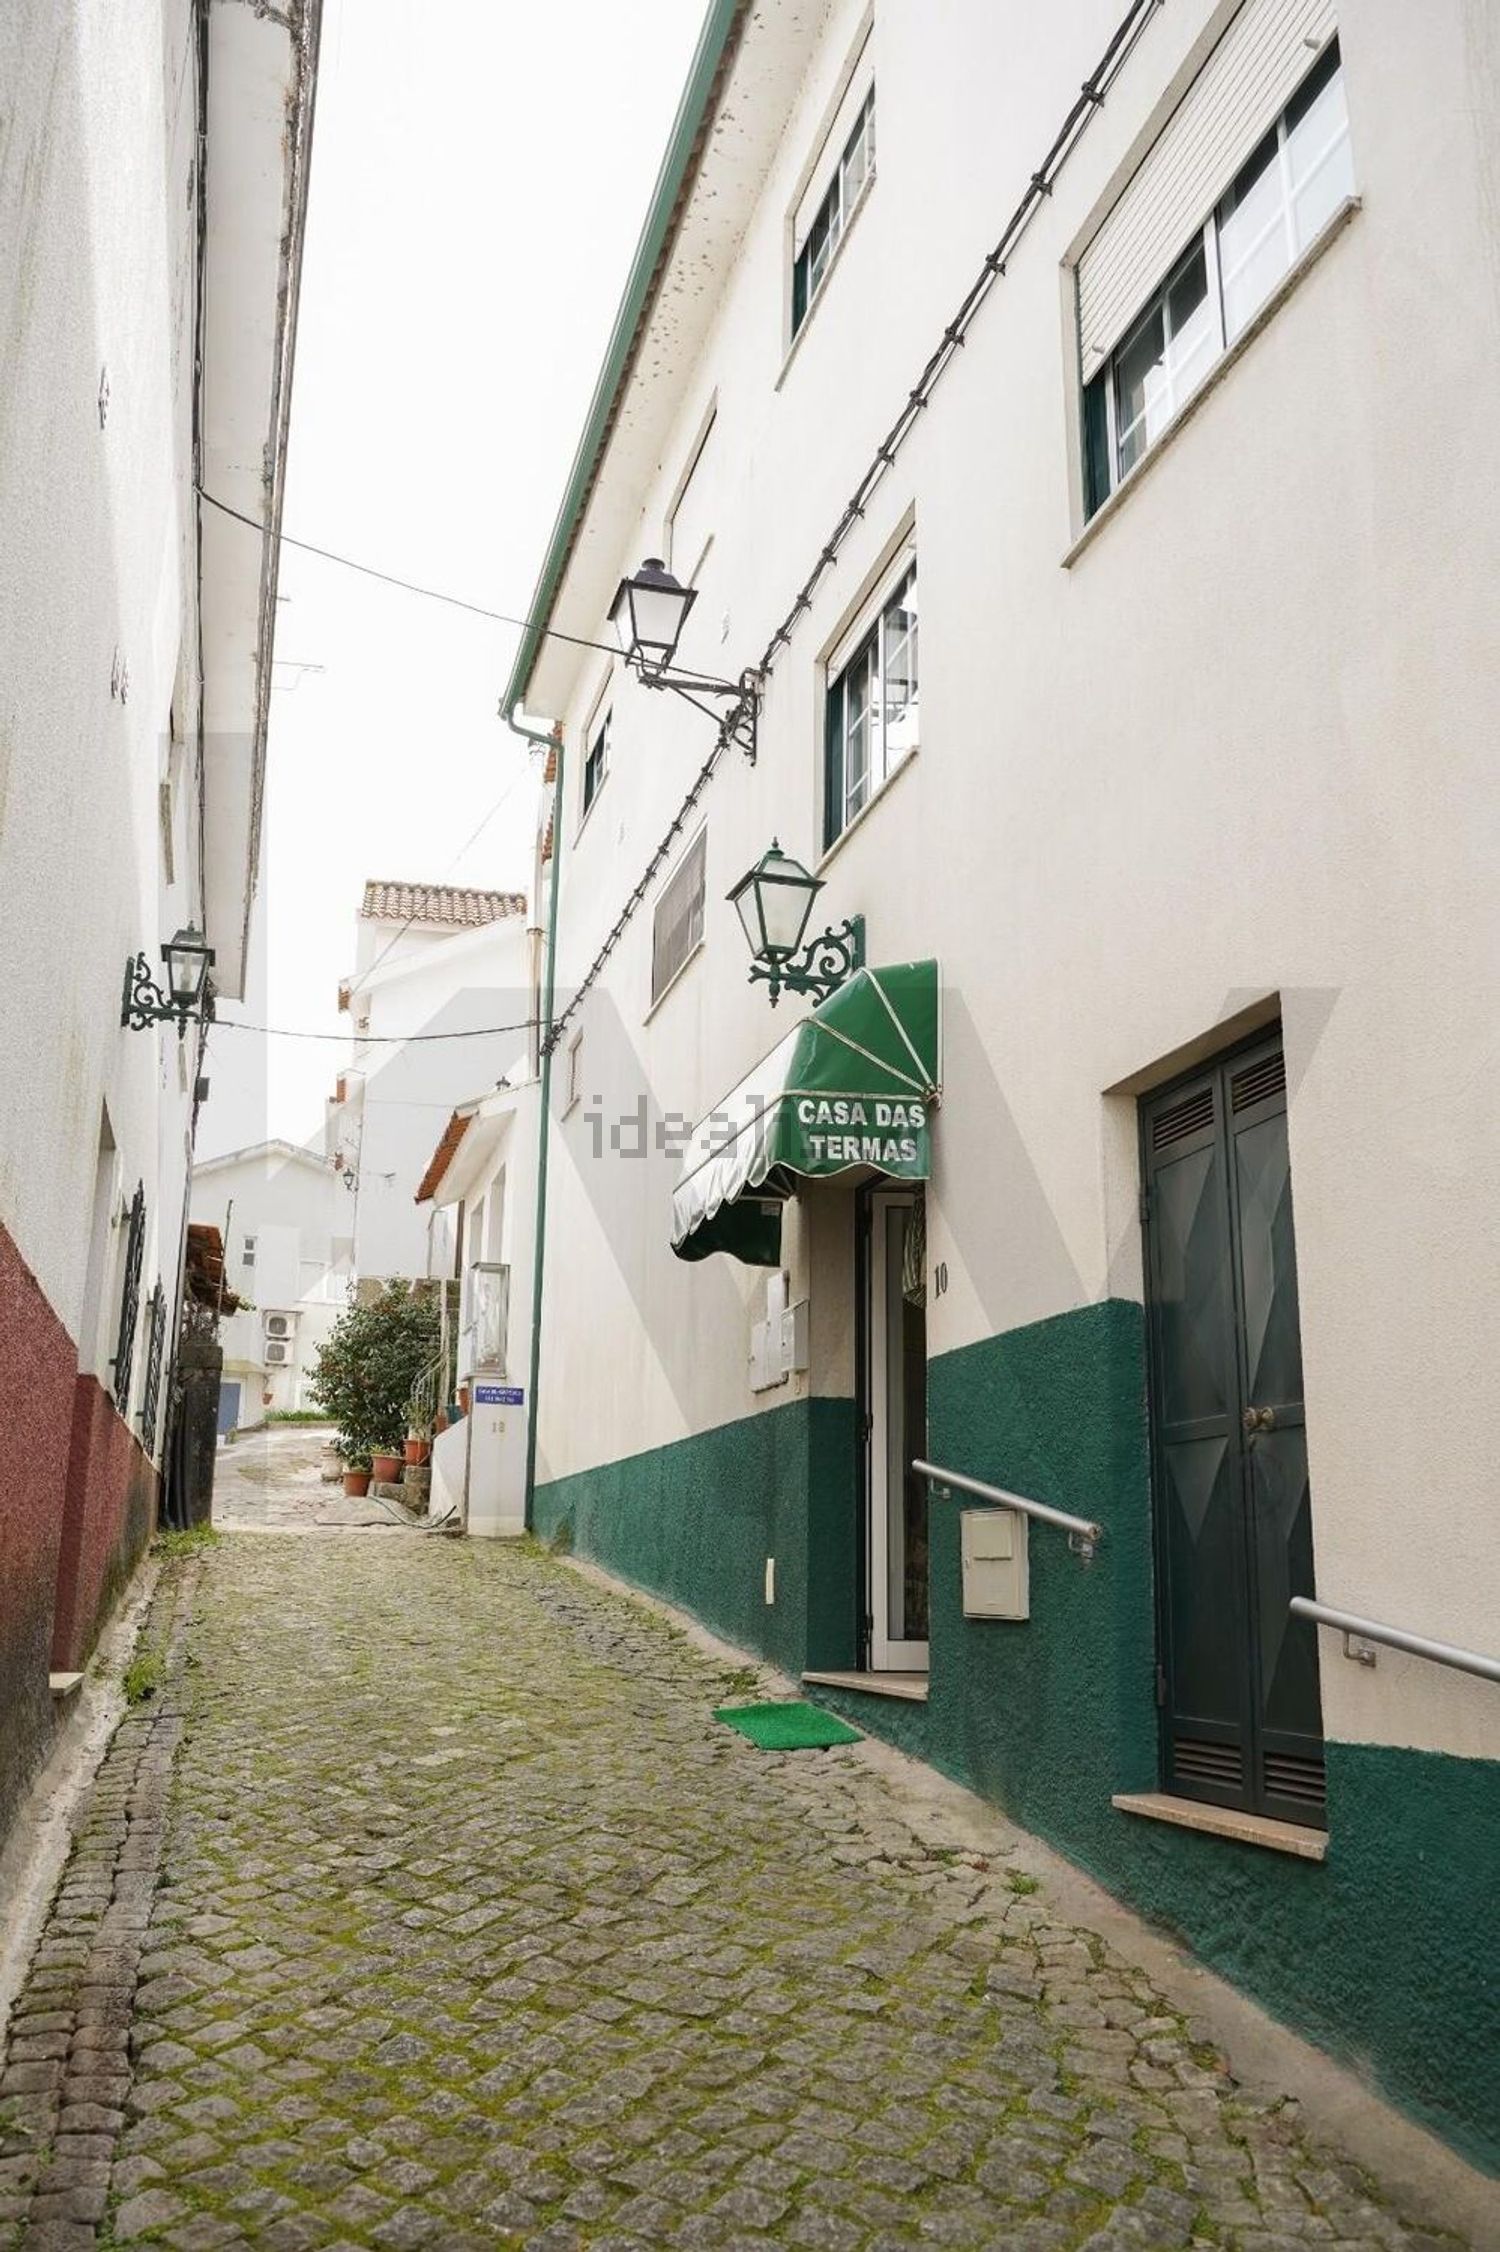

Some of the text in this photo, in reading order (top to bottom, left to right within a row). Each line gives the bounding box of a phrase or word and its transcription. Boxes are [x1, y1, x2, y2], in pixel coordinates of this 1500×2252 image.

[798, 1099, 926, 1128] CASA DAS
[809, 1134, 918, 1162] TERMAS
[934, 1261, 949, 1300] 10
